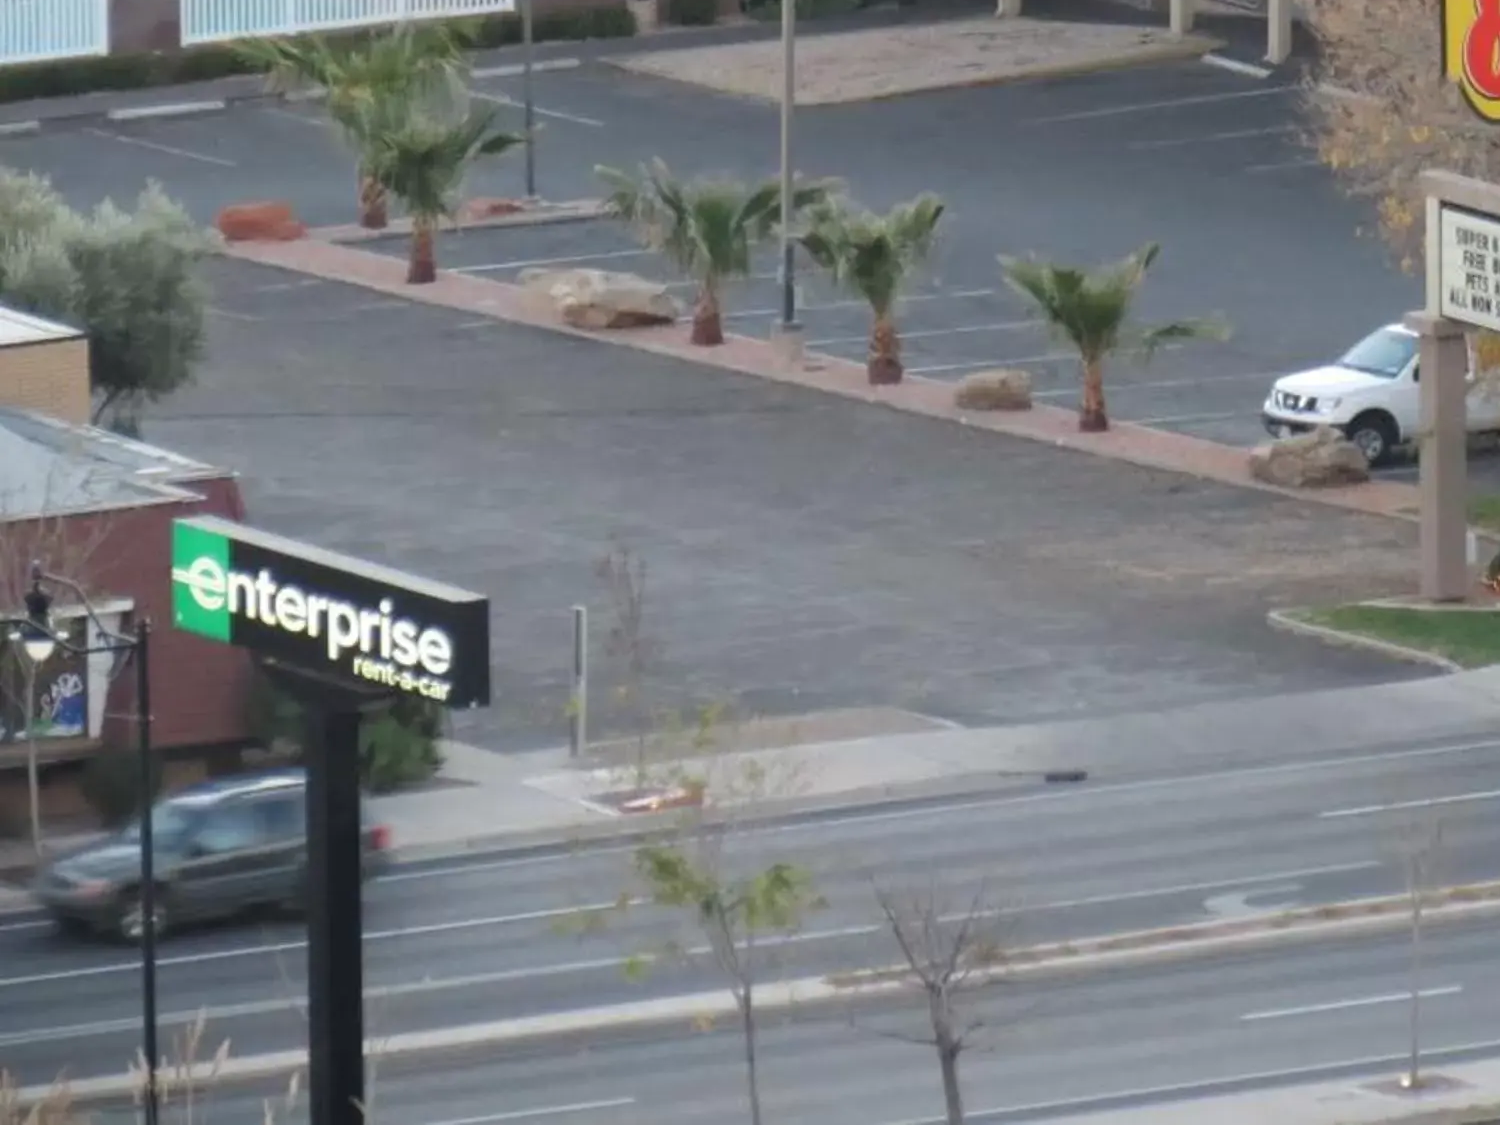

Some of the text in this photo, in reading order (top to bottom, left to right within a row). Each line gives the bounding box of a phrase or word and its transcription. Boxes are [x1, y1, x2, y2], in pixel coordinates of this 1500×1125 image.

[1455, 226, 1489, 252] SUPER
[1463, 249, 1486, 272] FREE
[1465, 272, 1489, 294] PETS
[1449, 287, 1467, 309] ALL
[1471, 293, 1492, 315] NON
[184, 555, 453, 676] enterprise
[352, 655, 452, 702] rent-a-car
